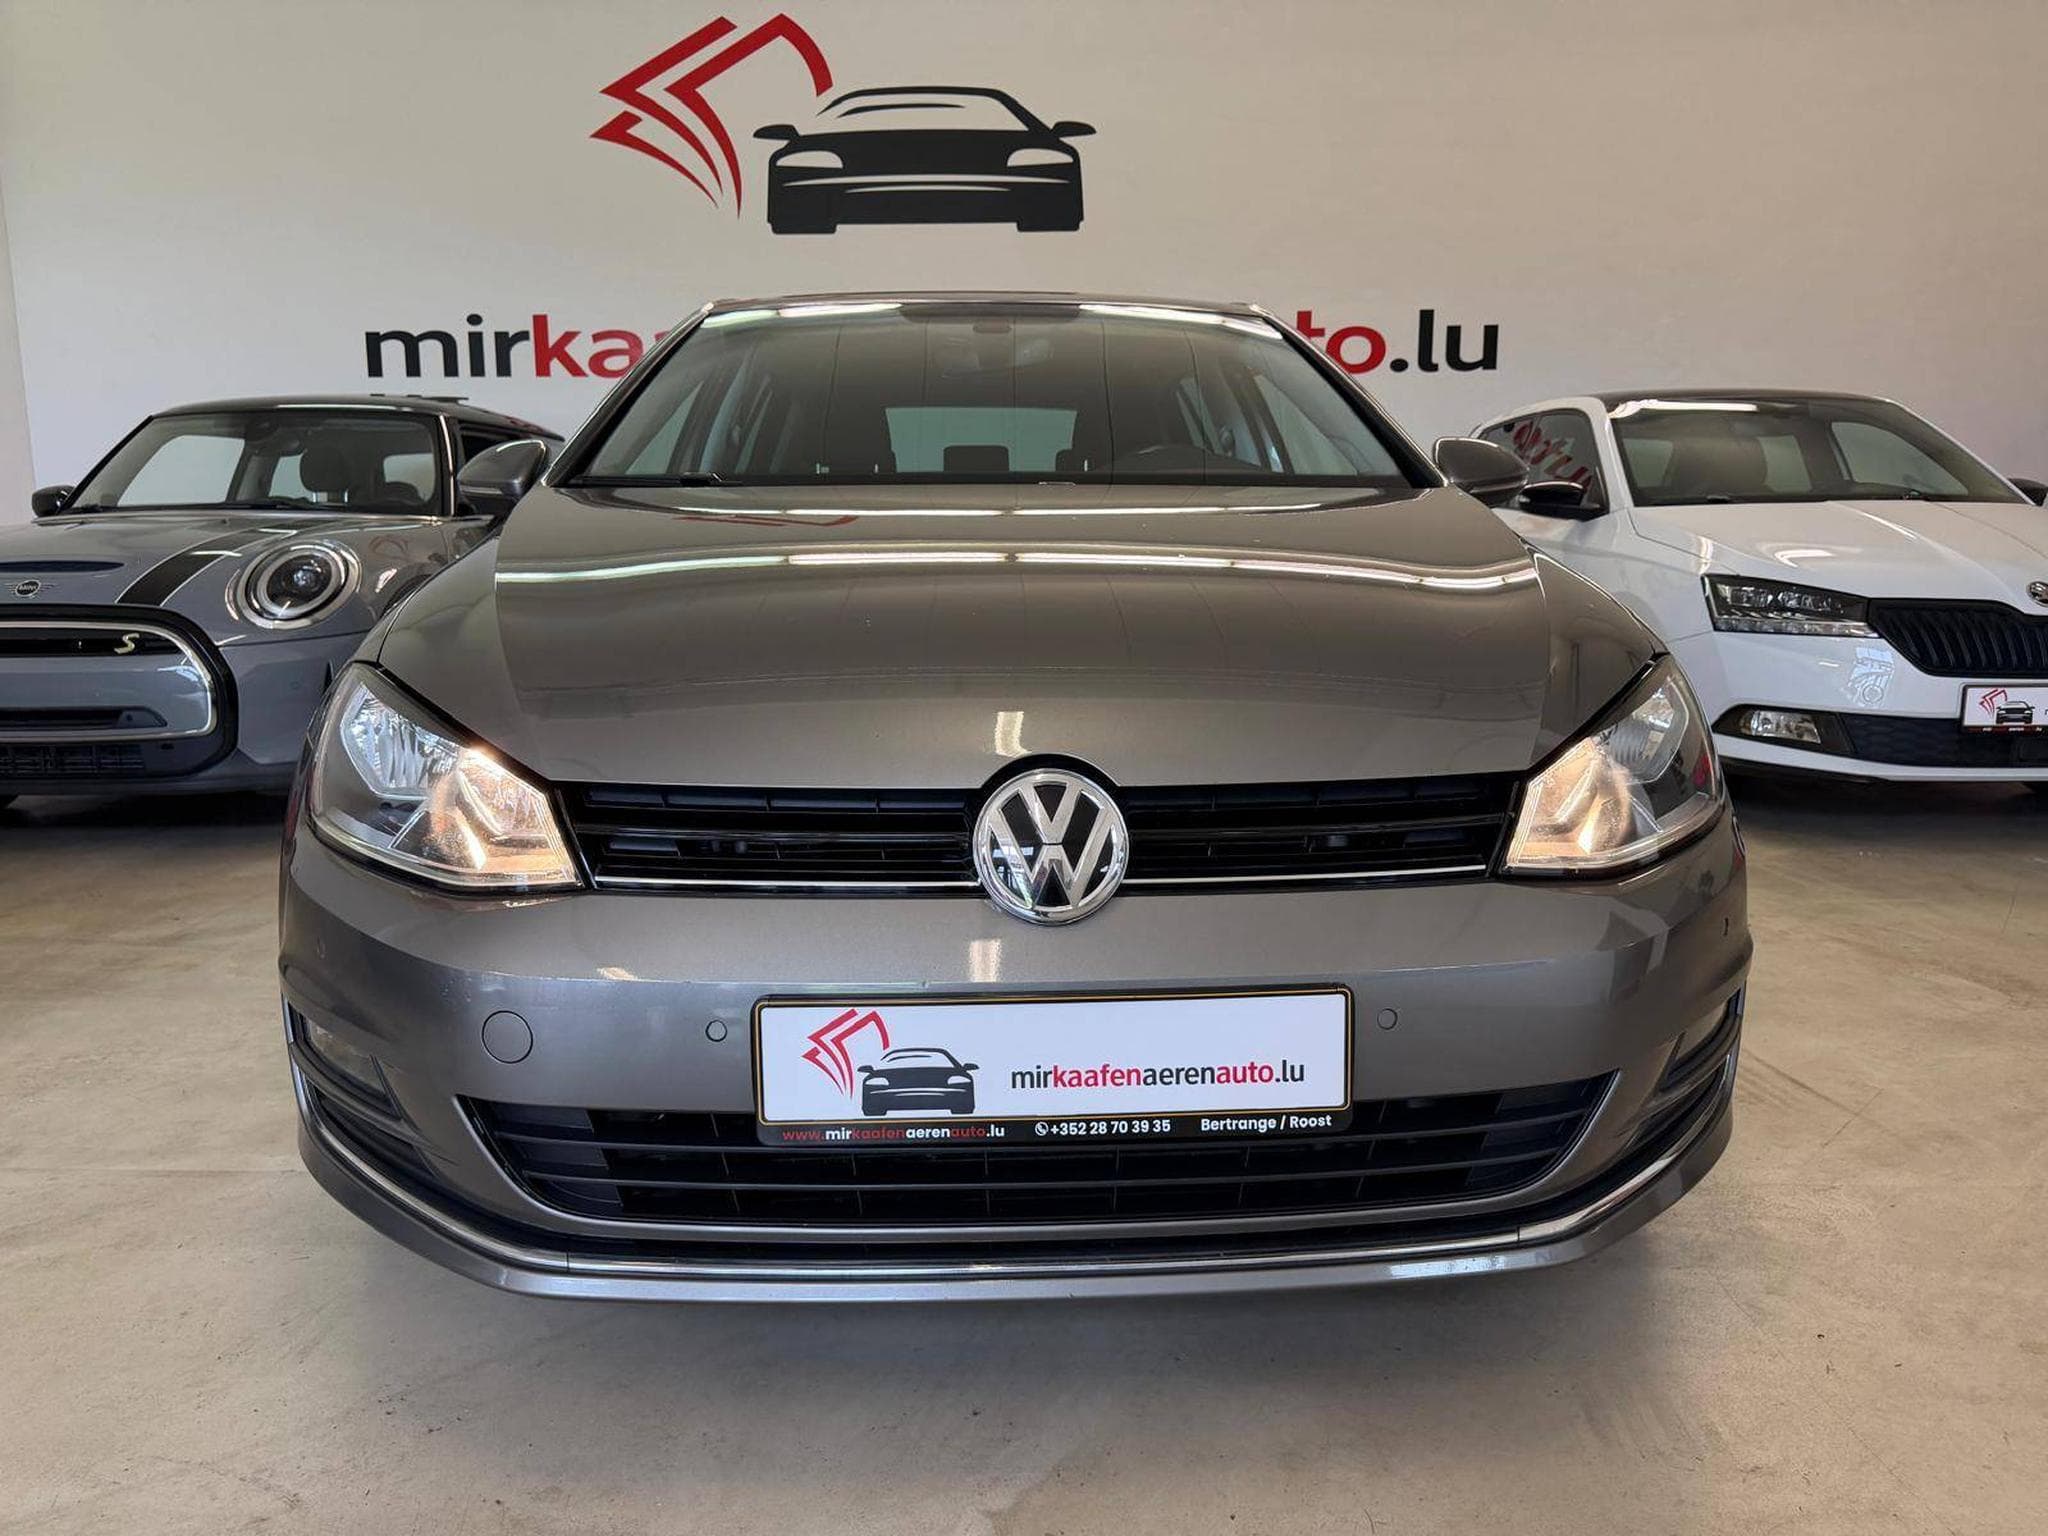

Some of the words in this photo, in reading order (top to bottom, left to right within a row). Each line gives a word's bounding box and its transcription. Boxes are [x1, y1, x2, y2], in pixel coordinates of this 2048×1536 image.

[365, 313, 671, 378] mirka
[1011, 1059, 1305, 1090] mirkaafenaerenauto.lu
[782, 1124, 1005, 1142] www.mirkaafenaerenauto.lu
[1089, 1121, 1108, 1135] 28
[1110, 1120, 1129, 1134] 70
[1131, 1120, 1150, 1134] 39
[1152, 1119, 1171, 1133] 35
[1200, 1116, 1277, 1133] Bertrange
[1289, 1113, 1333, 1129] Roost
